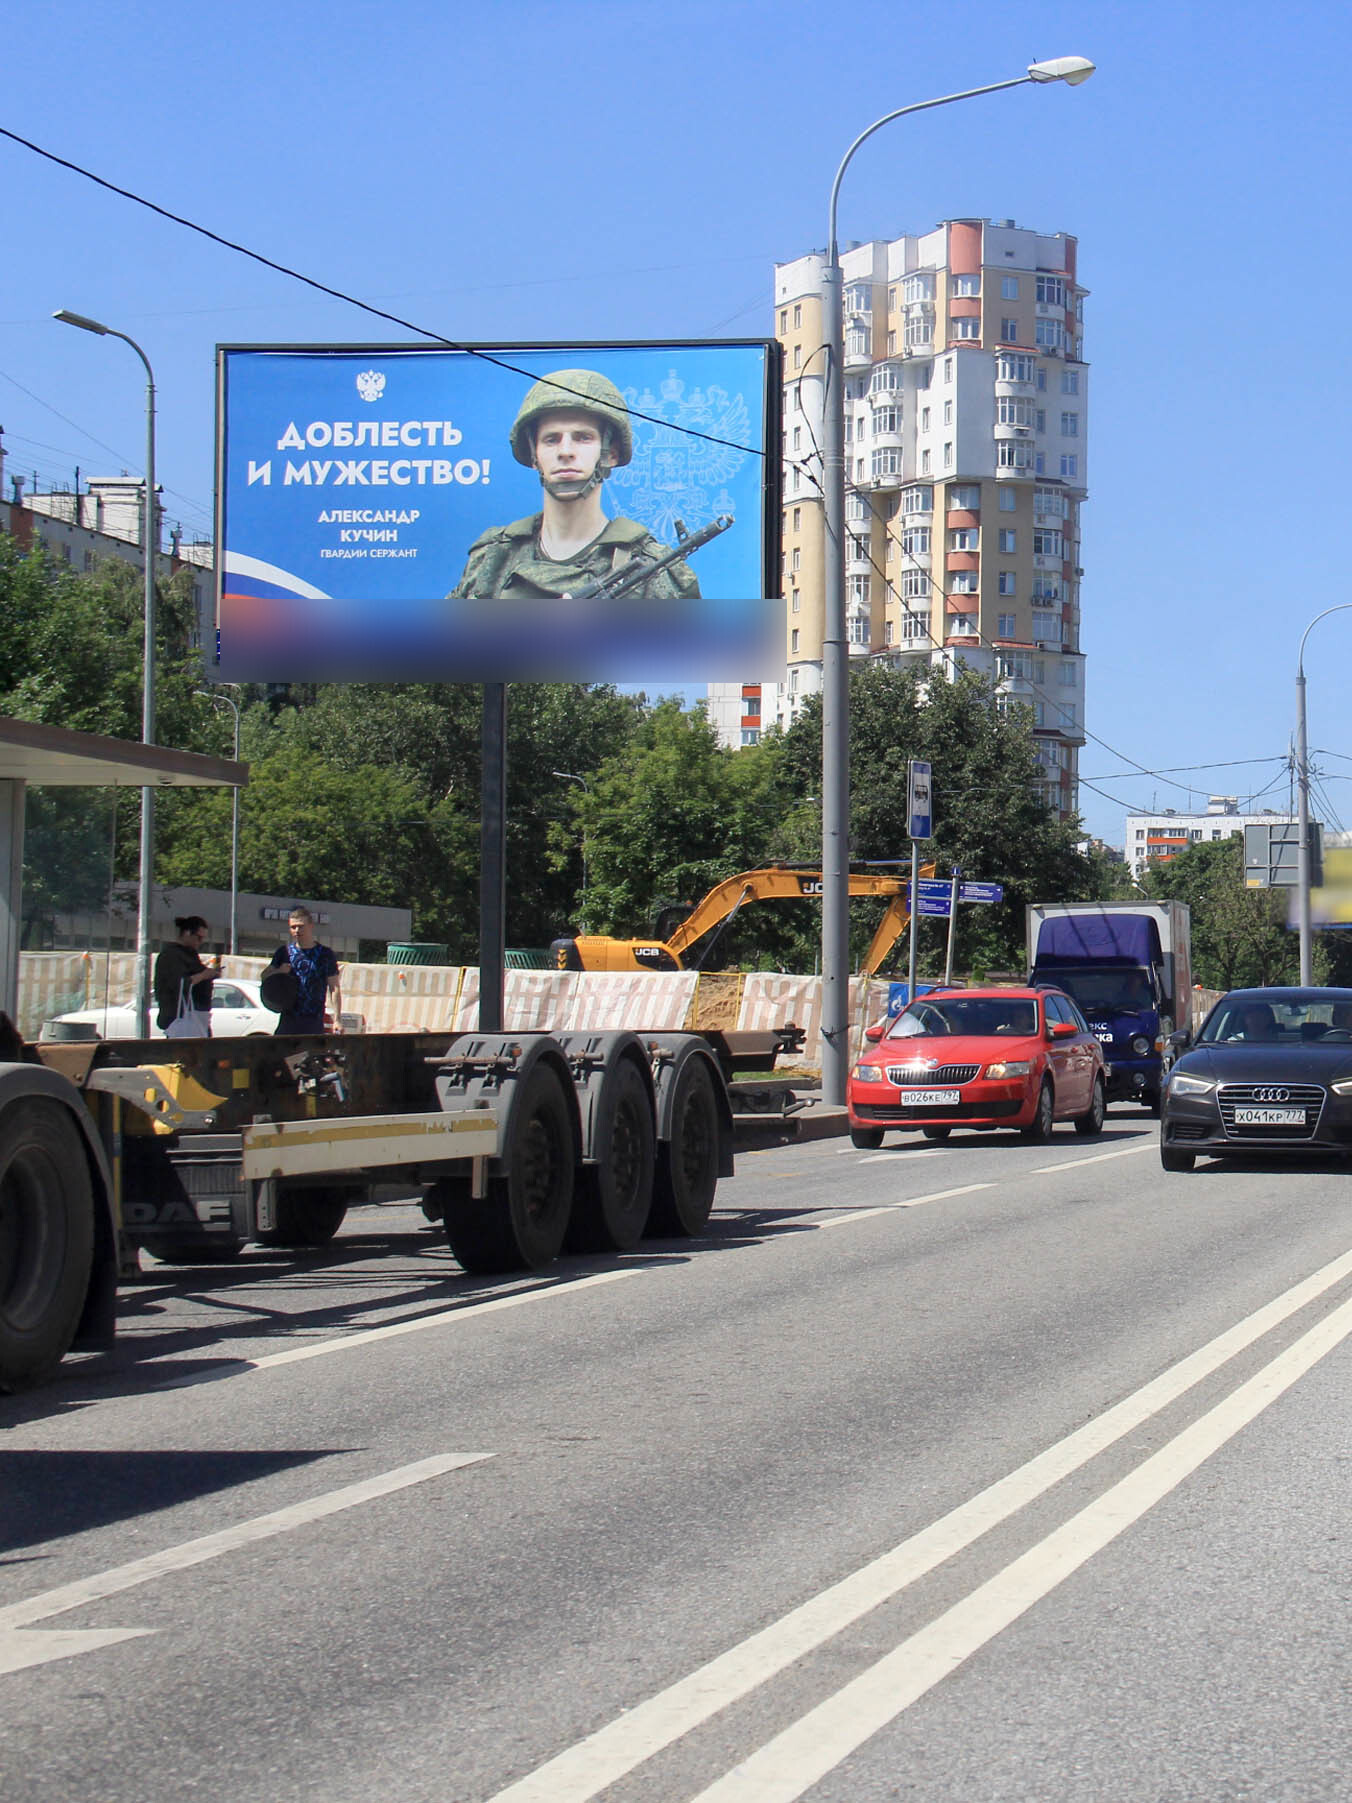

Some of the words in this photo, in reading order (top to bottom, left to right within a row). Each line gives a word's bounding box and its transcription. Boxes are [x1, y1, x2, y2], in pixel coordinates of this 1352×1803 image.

[277, 421, 462, 450] ДОБЛЕСТЬ
[248, 461, 271, 485] И
[283, 459, 491, 485] МУЖЕСТВО!
[317, 510, 420, 524] АЛЕКСАНДР
[340, 529, 398, 542] КУЧИН
[320, 549, 367, 559] ГВАРДИИ
[370, 549, 418, 558] СЕРЖАНТ
[803, 882, 823, 894] JC
[635, 948, 660, 956] JCB
[904, 1092, 941, 1103] В026КЕ
[1239, 1110, 1283, 1123] Х041КР
[122, 1200, 231, 1223] DAF
